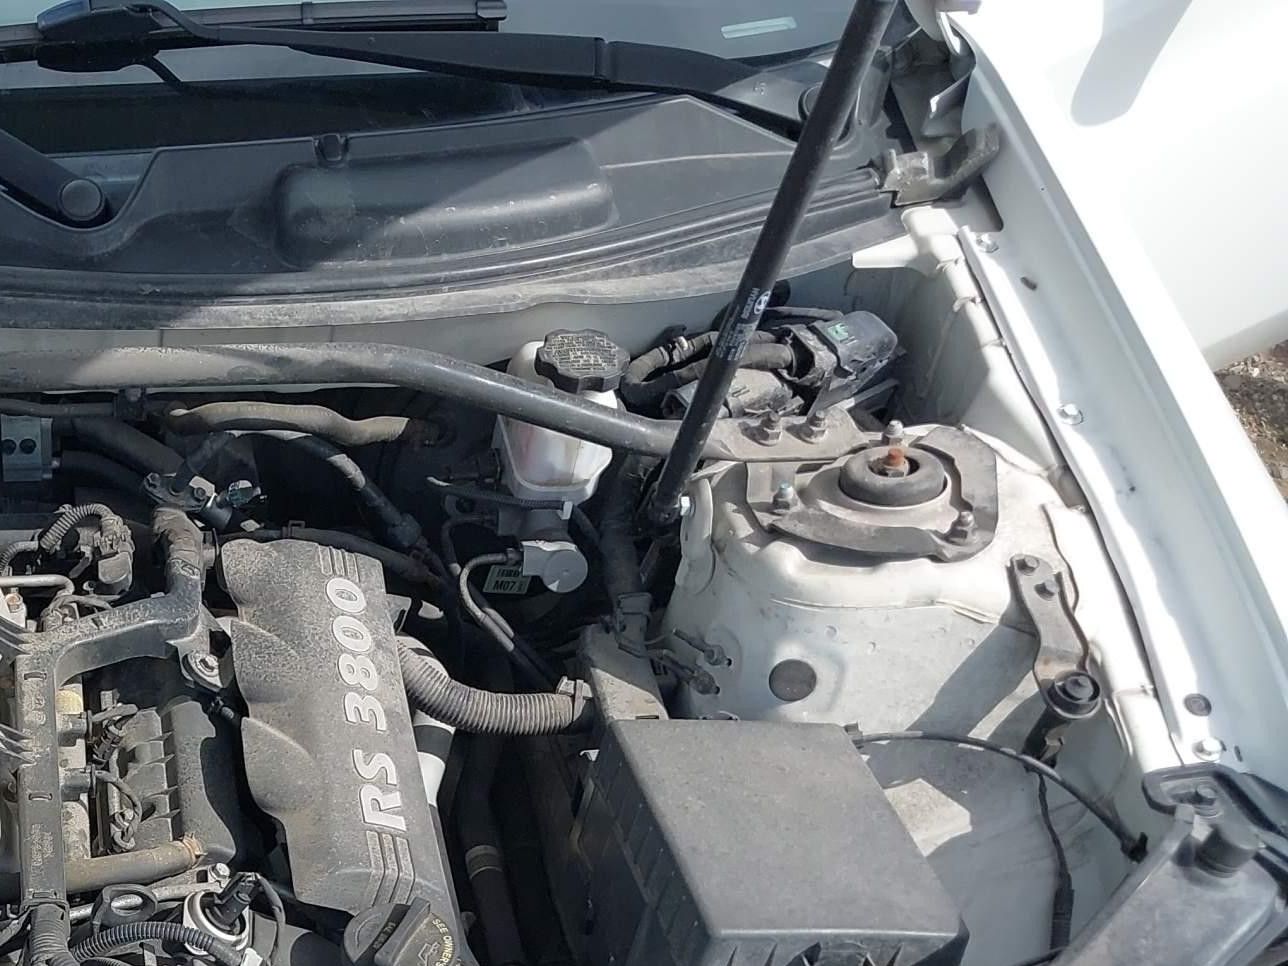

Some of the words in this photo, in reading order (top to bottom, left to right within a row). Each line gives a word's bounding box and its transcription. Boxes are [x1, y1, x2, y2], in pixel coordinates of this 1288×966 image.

[326, 576, 386, 731] 3800
[352, 748, 406, 831] RS
[432, 918, 449, 934] SEE
